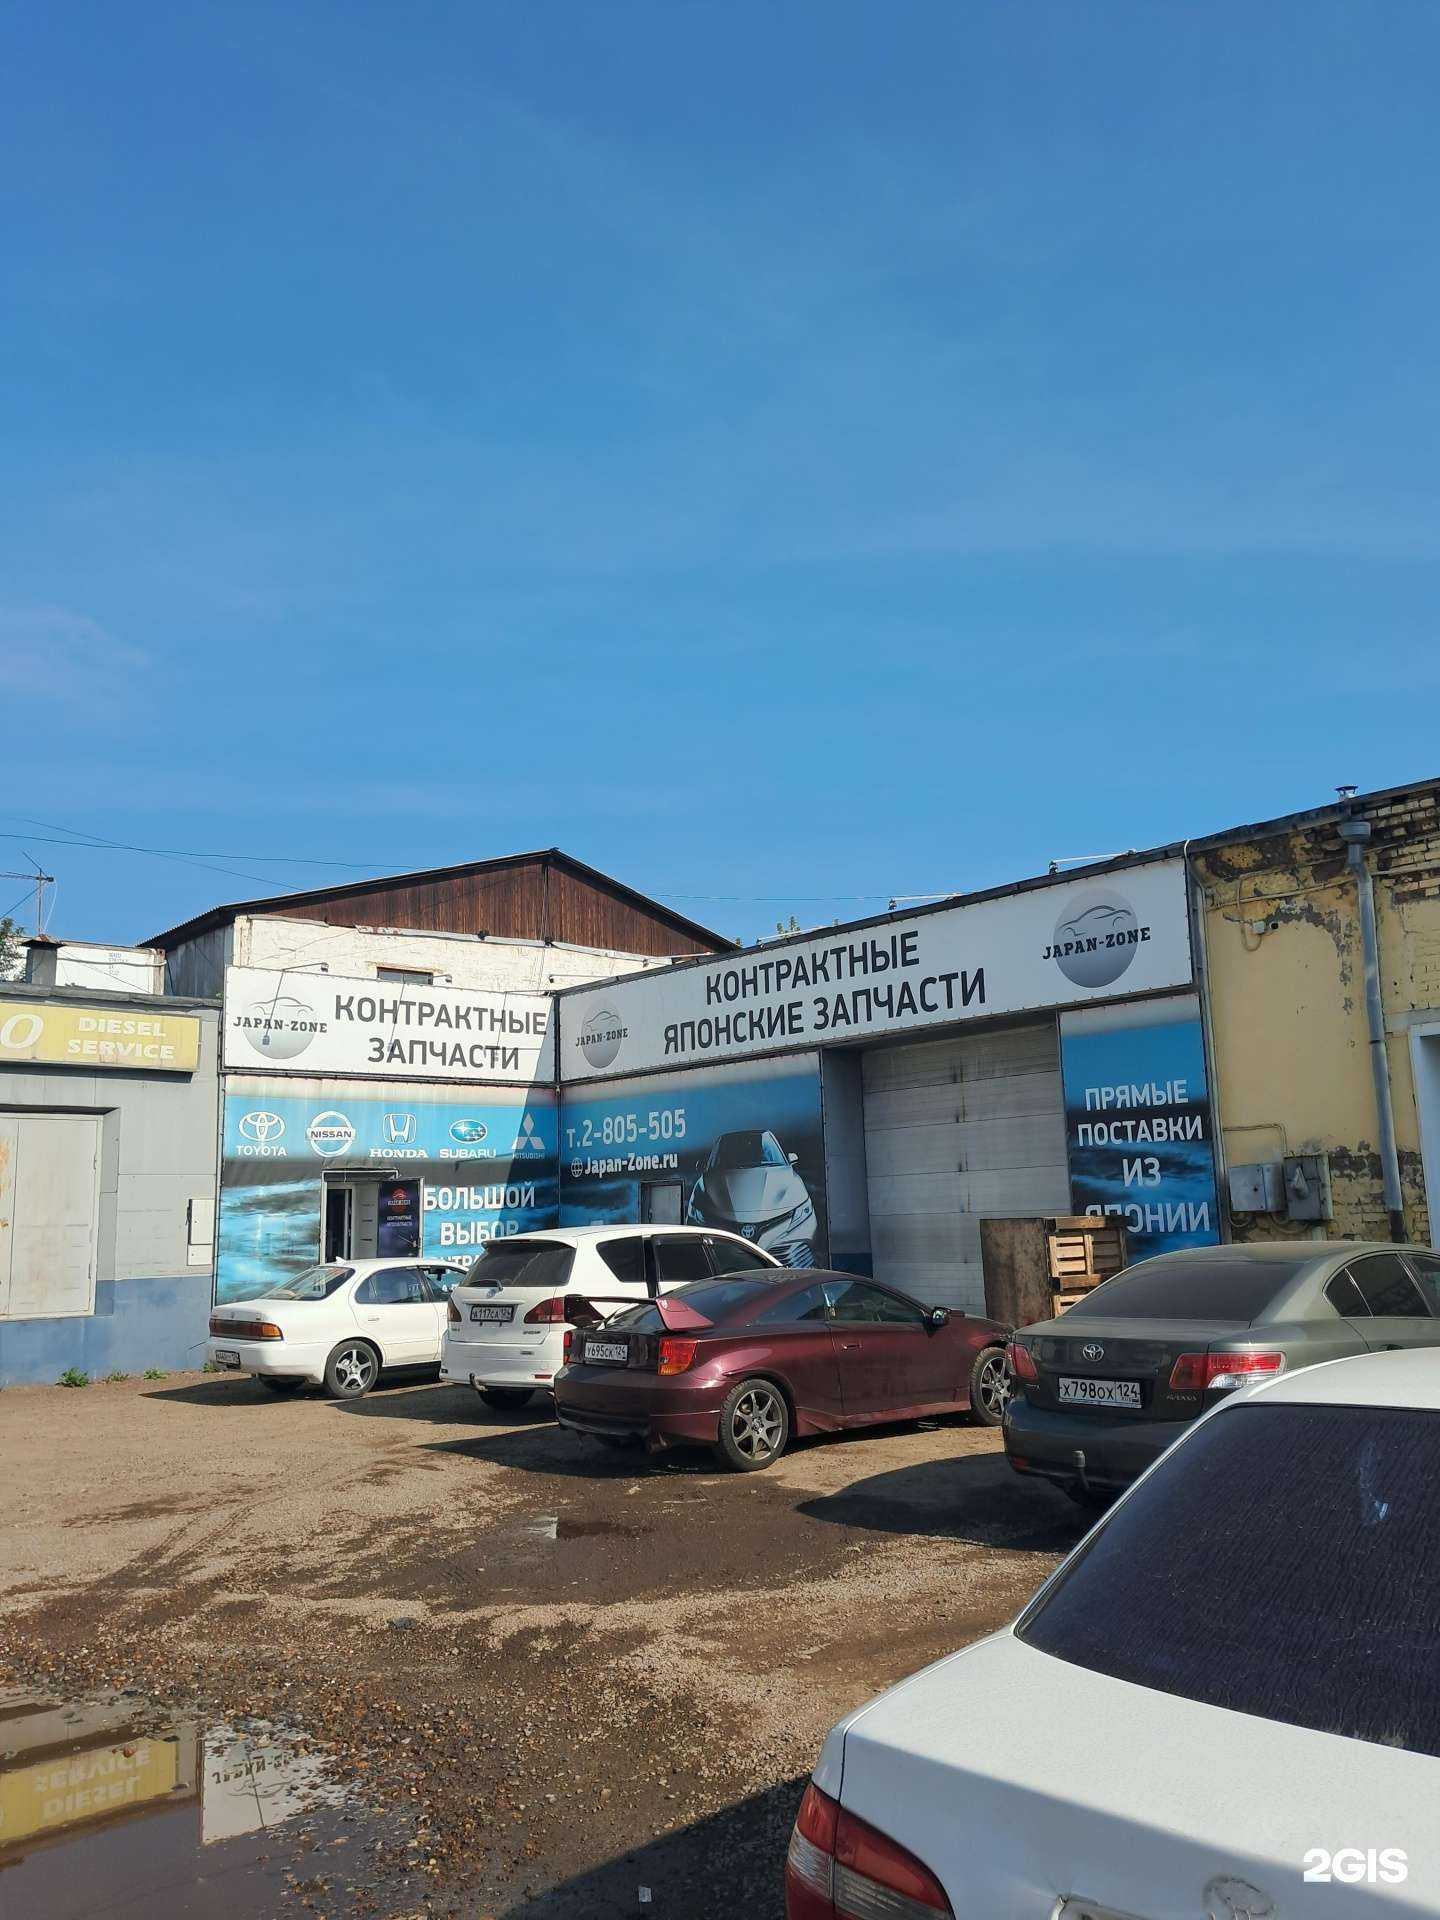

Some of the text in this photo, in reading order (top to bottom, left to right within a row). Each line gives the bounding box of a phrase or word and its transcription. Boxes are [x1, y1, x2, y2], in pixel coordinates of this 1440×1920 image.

[1042, 926, 1151, 960] JAPAN-ZONE
[706, 930, 920, 1006] КОНТРАКТНЫЕ
[233, 1015, 328, 1034] JAPAN-ZONE
[335, 994, 547, 1036] КОНТРАКТНЫЕ
[663, 967, 986, 1055] ЯПОНСКИЕ ЗАПЧАСТИ
[78, 1016, 167, 1038] DIESEL
[575, 1027, 629, 1047] JAPAN-ZONE
[66, 1038, 176, 1060] SERVICE
[367, 1036, 520, 1071] ЗАПЧАСТИ
[1085, 1079, 1189, 1112] ПРЯМЫЕ
[310, 1129, 353, 1139] NISSAN
[1077, 1115, 1203, 1147] ПОСТАВКИ
[236, 1144, 287, 1157] TOYOTA
[368, 1147, 430, 1159] HONDA
[439, 1147, 497, 1159] SUBARU
[584, 1151, 679, 1179] Japan-Zone.ru
[1122, 1157, 1162, 1187] ИЗ
[423, 1180, 536, 1212] БОЛЬШОЙ
[440, 1220, 520, 1247] ВЫБОР
[1116, 1383, 1139, 1399] 124
